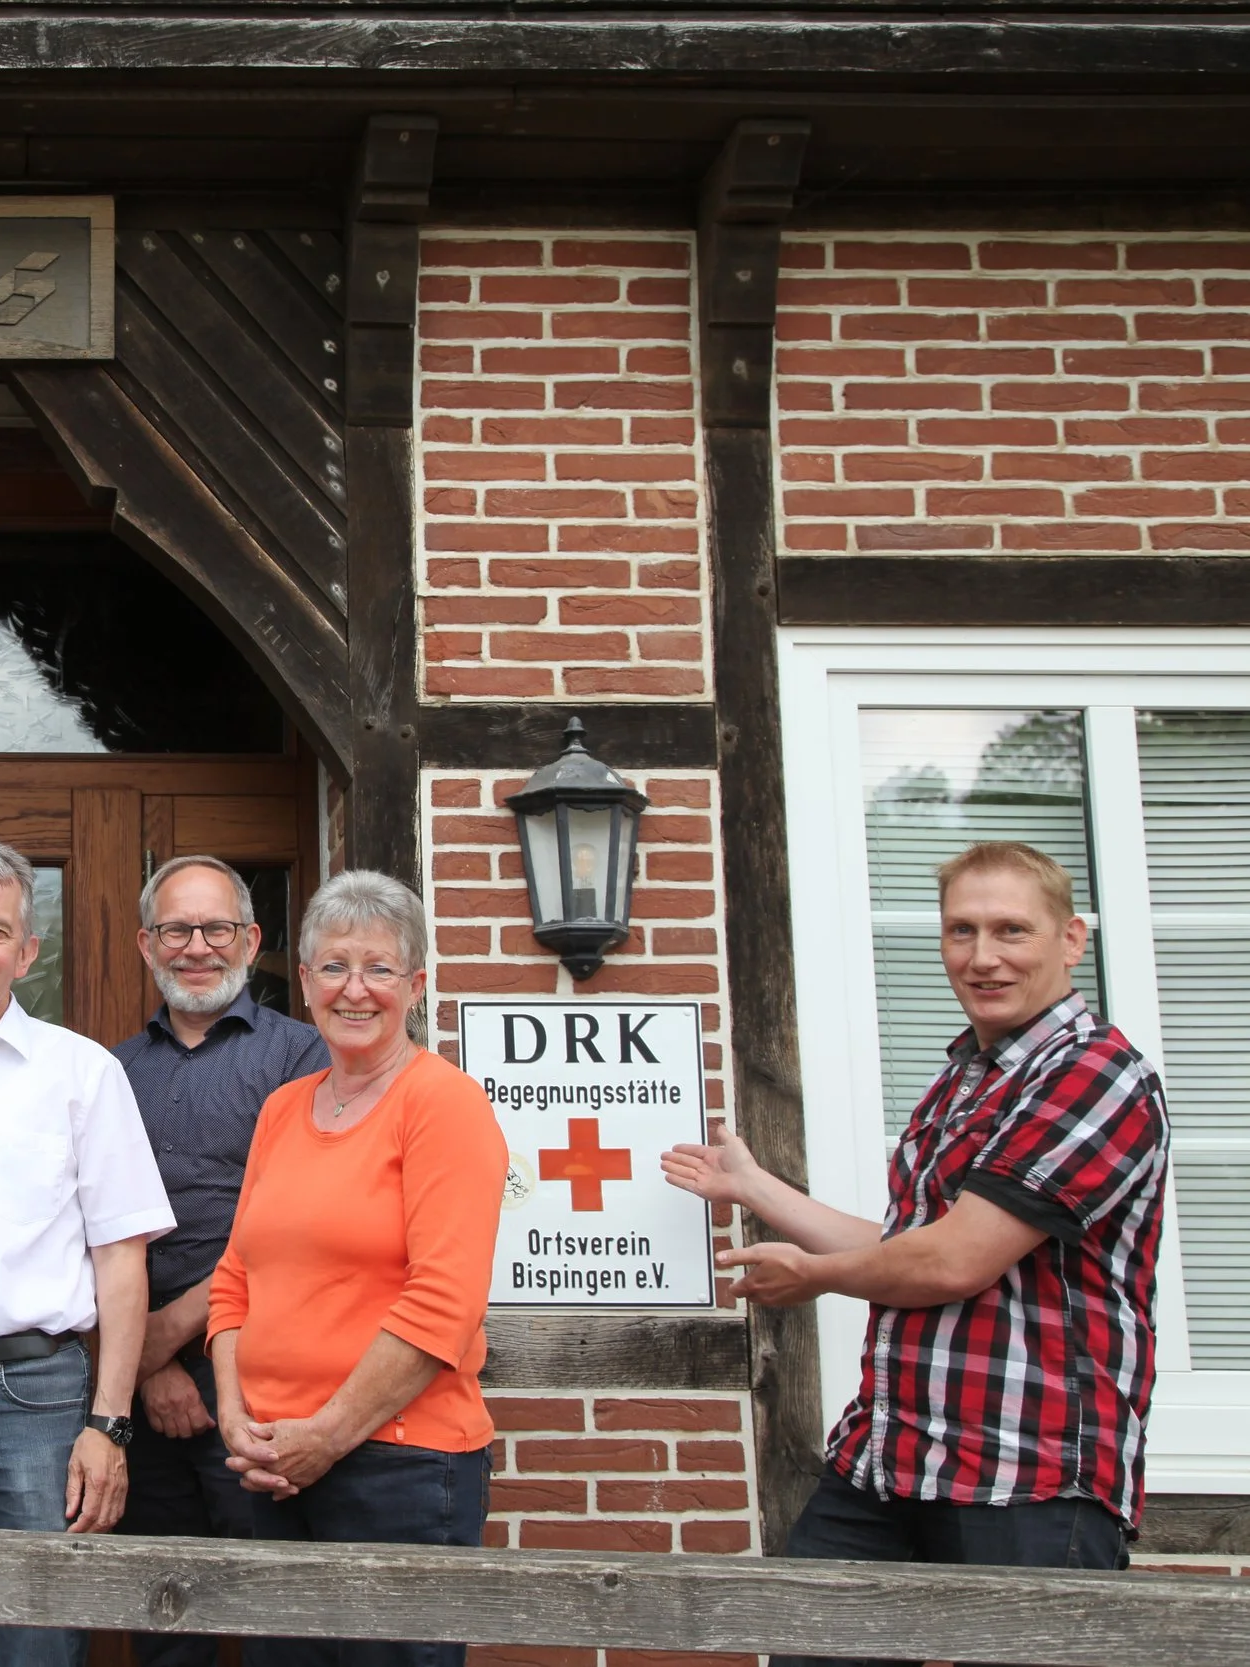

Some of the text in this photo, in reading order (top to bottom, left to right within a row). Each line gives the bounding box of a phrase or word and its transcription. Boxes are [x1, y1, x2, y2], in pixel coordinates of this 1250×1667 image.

[501, 1013, 661, 1064] DRK
[483, 1077, 681, 1111] Begegnungsstätte
[528, 1228, 651, 1256] Ortsverein
[512, 1262, 669, 1296] Bispingen e.V.
